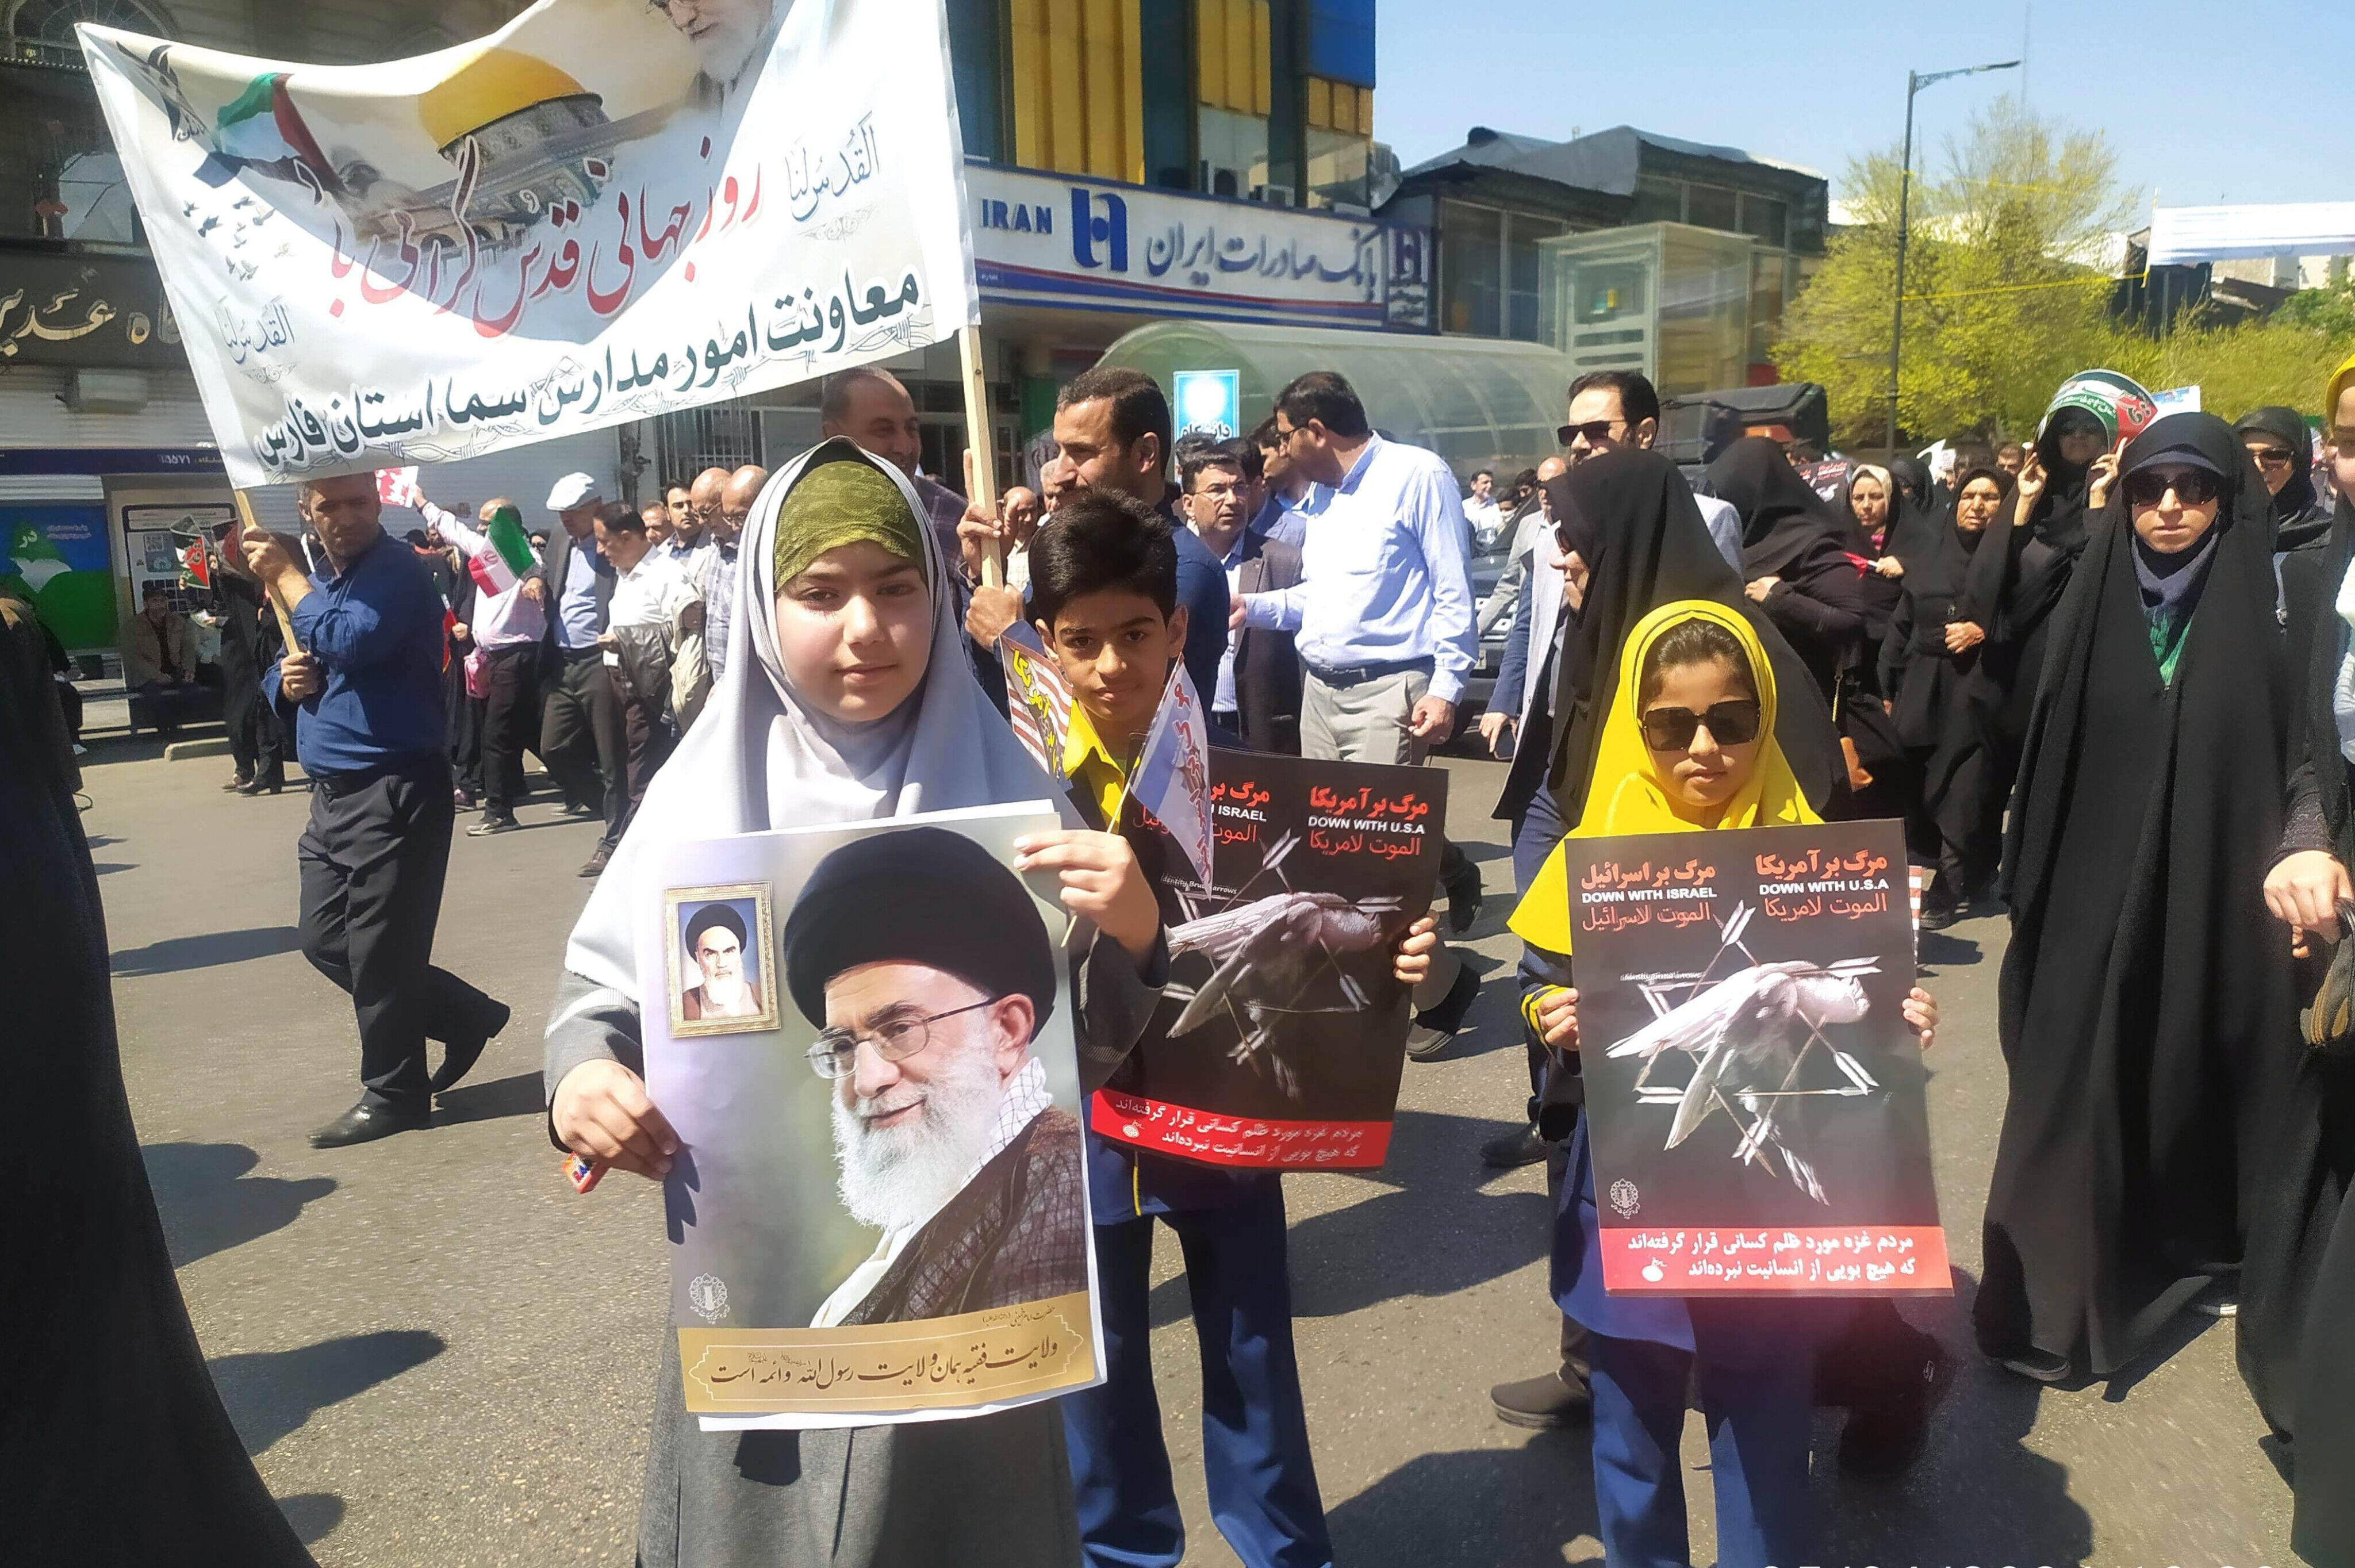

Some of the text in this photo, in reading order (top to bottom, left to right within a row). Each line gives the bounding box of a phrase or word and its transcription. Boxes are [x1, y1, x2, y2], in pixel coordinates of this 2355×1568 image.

[981, 198, 1053, 235] IRAN
[1146, 221, 1380, 302] بانک صادرات ایران
[260, 267, 920, 464] معاونت امور مدارس سما استان فارس
[1229, 781, 1269, 807] مرگ
[1310, 786, 1429, 821] مرگ بر آمریکا
[1218, 804, 1267, 822] ISRAEL
[1308, 815, 1426, 834] DOWN WITH U.S.A
[1368, 837, 1421, 860] الموت
[1581, 857, 1716, 890] مرگ بر اسرائیل
[1755, 848, 1888, 881] مرگ بر آمریکا
[1582, 887, 1718, 904] DOWN WITH ISRAEL
[1759, 879, 1889, 896] DOWN WITH U.S.A
[1656, 902, 1711, 929] الموت
[1829, 892, 1888, 920] الموت
[1168, 1110, 1195, 1129] قرار
[1196, 1118, 1244, 1133] کسانی
[1242, 1123, 1269, 1139] ظلم
[1271, 1127, 1302, 1142] مورد
[1330, 1127, 1364, 1142] مردم
[1212, 1143, 1267, 1158] انسانیت
[1267, 1144, 1280, 1162] از
[1315, 1148, 1340, 1162] هیچ
[1344, 1144, 1361, 1157] که
[1691, 1232, 1719, 1255] قرار
[1723, 1232, 1769, 1255] کسانی
[1773, 1232, 1802, 1255] ظلم
[1805, 1236, 1839, 1255] مورد
[1844, 1230, 1871, 1255] غزه
[1877, 1235, 1914, 1253] مردم
[1746, 1258, 1804, 1280] انسانیت
[1809, 1258, 1821, 1282] از
[1826, 1264, 1862, 1282] بویی
[1866, 1261, 1896, 1282] هیچ
[1900, 1256, 1916, 1275] که
[985, 1335, 1058, 1369] ولایت
[816, 1358, 854, 1390] رسول
[962, 1342, 987, 1385] فقیه
[711, 1366, 755, 1383] است
